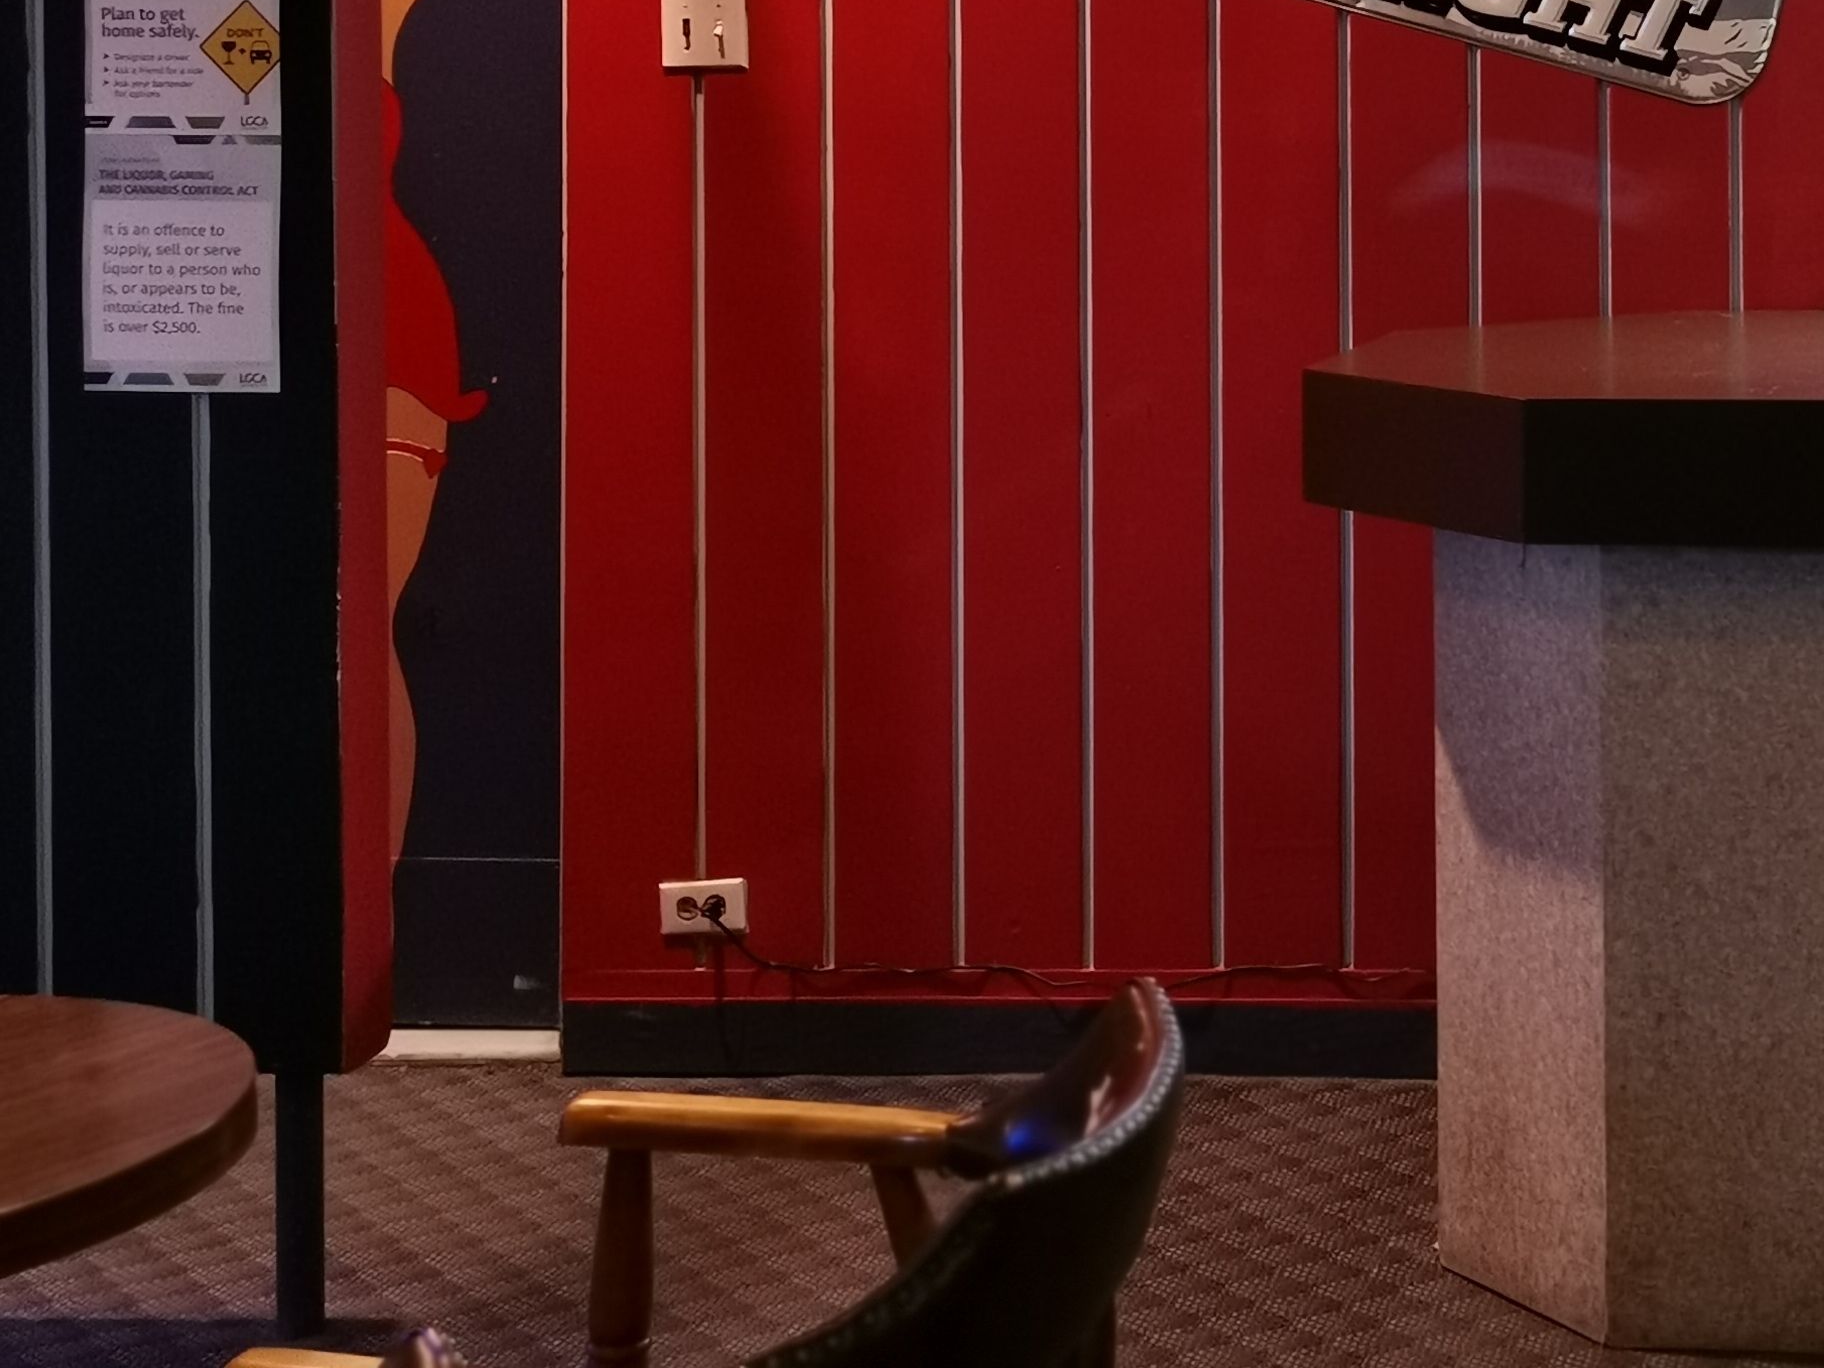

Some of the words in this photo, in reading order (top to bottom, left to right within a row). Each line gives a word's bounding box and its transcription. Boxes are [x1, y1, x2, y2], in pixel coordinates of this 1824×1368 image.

[101, 7, 135, 21] Plan
[140, 9, 156, 21] to
[160, 8, 185, 25] get
[102, 24, 144, 38] home
[149, 23, 200, 41] safely.
[237, 185, 259, 196] ACT
[117, 222, 129, 236] is
[132, 225, 150, 236] an
[153, 223, 206, 237] offence
[210, 226, 225, 237] to
[103, 243, 152, 258] supply,
[156, 243, 181, 256] sell
[184, 245, 200, 256] or
[203, 245, 242, 256] serve
[148, 264, 162, 275] to
[166, 265, 175, 275] a
[179, 265, 227, 278] person
[232, 263, 261, 276] who
[121, 283, 137, 295] or
[140, 283, 197, 297] appears
[201, 283, 215, 295] to
[103, 300, 184, 314] intoxicated.
[188, 301, 214, 314] The
[217, 301, 244, 314] fine
[103, 319, 114, 332] is
[118, 321, 148, 332] over
[152, 320, 201, 334] $2,500.
